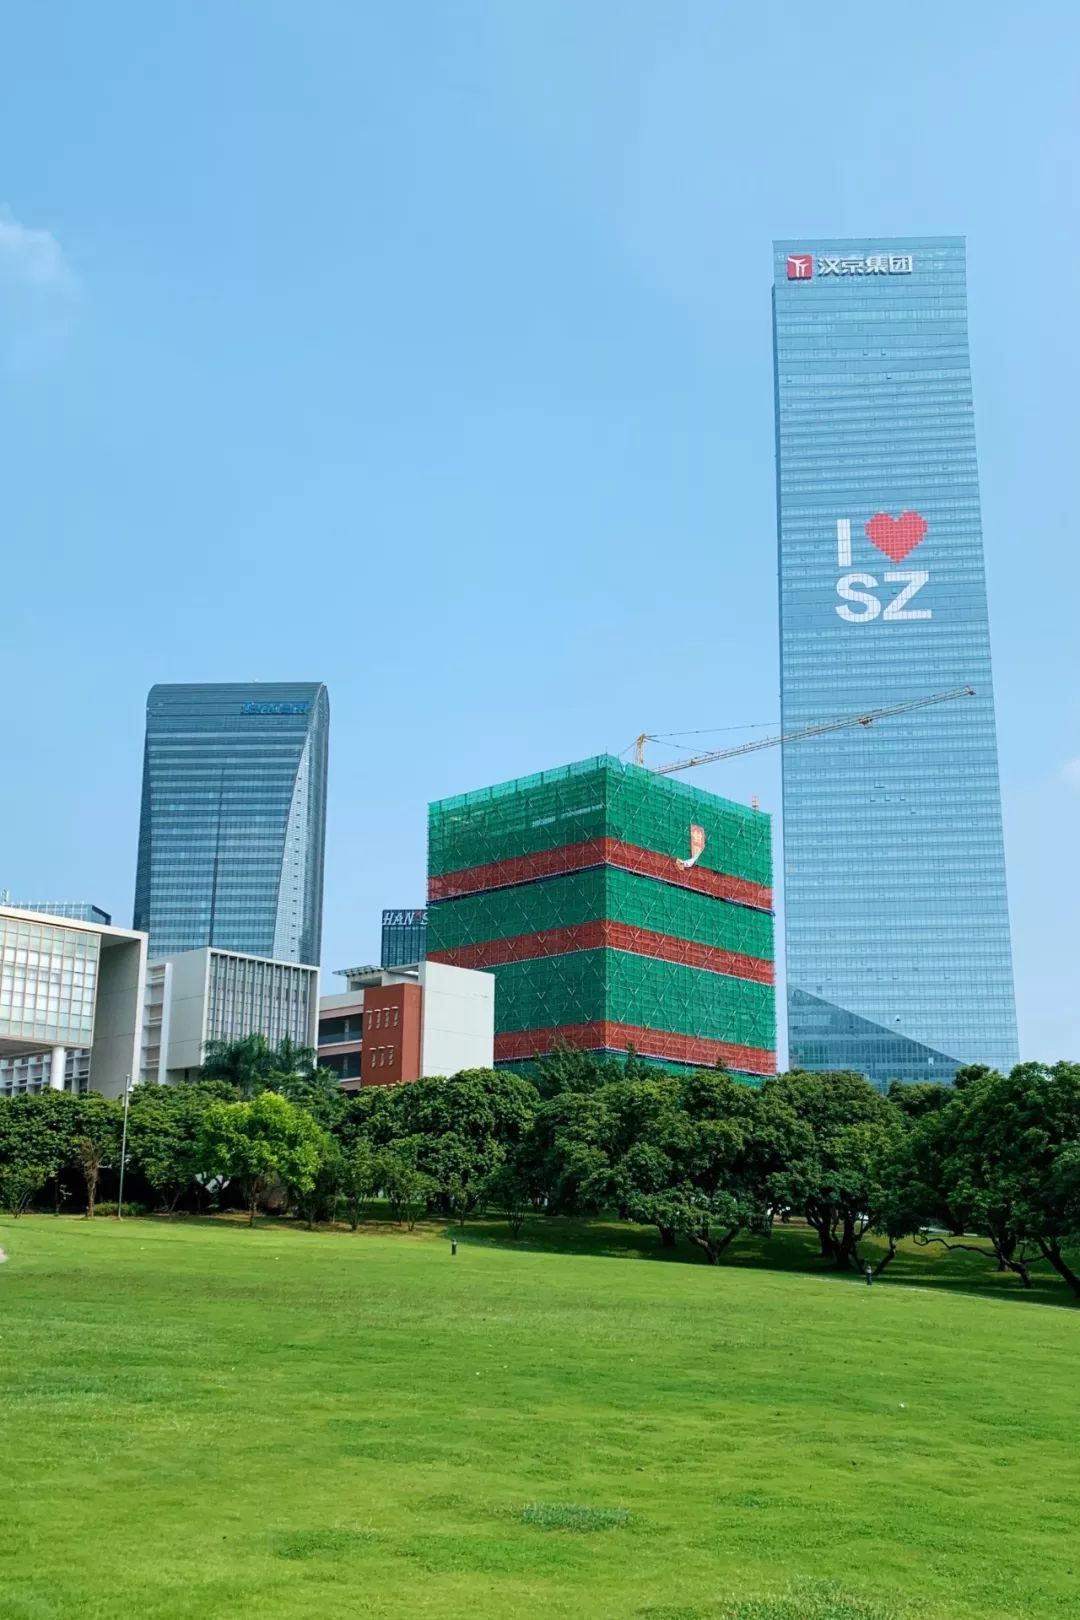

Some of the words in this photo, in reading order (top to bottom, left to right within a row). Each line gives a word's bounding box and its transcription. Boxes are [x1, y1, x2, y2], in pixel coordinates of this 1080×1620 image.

[817, 255, 913, 276] 汉京集团
[837, 519, 852, 567] I
[835, 570, 932, 622] SZ
